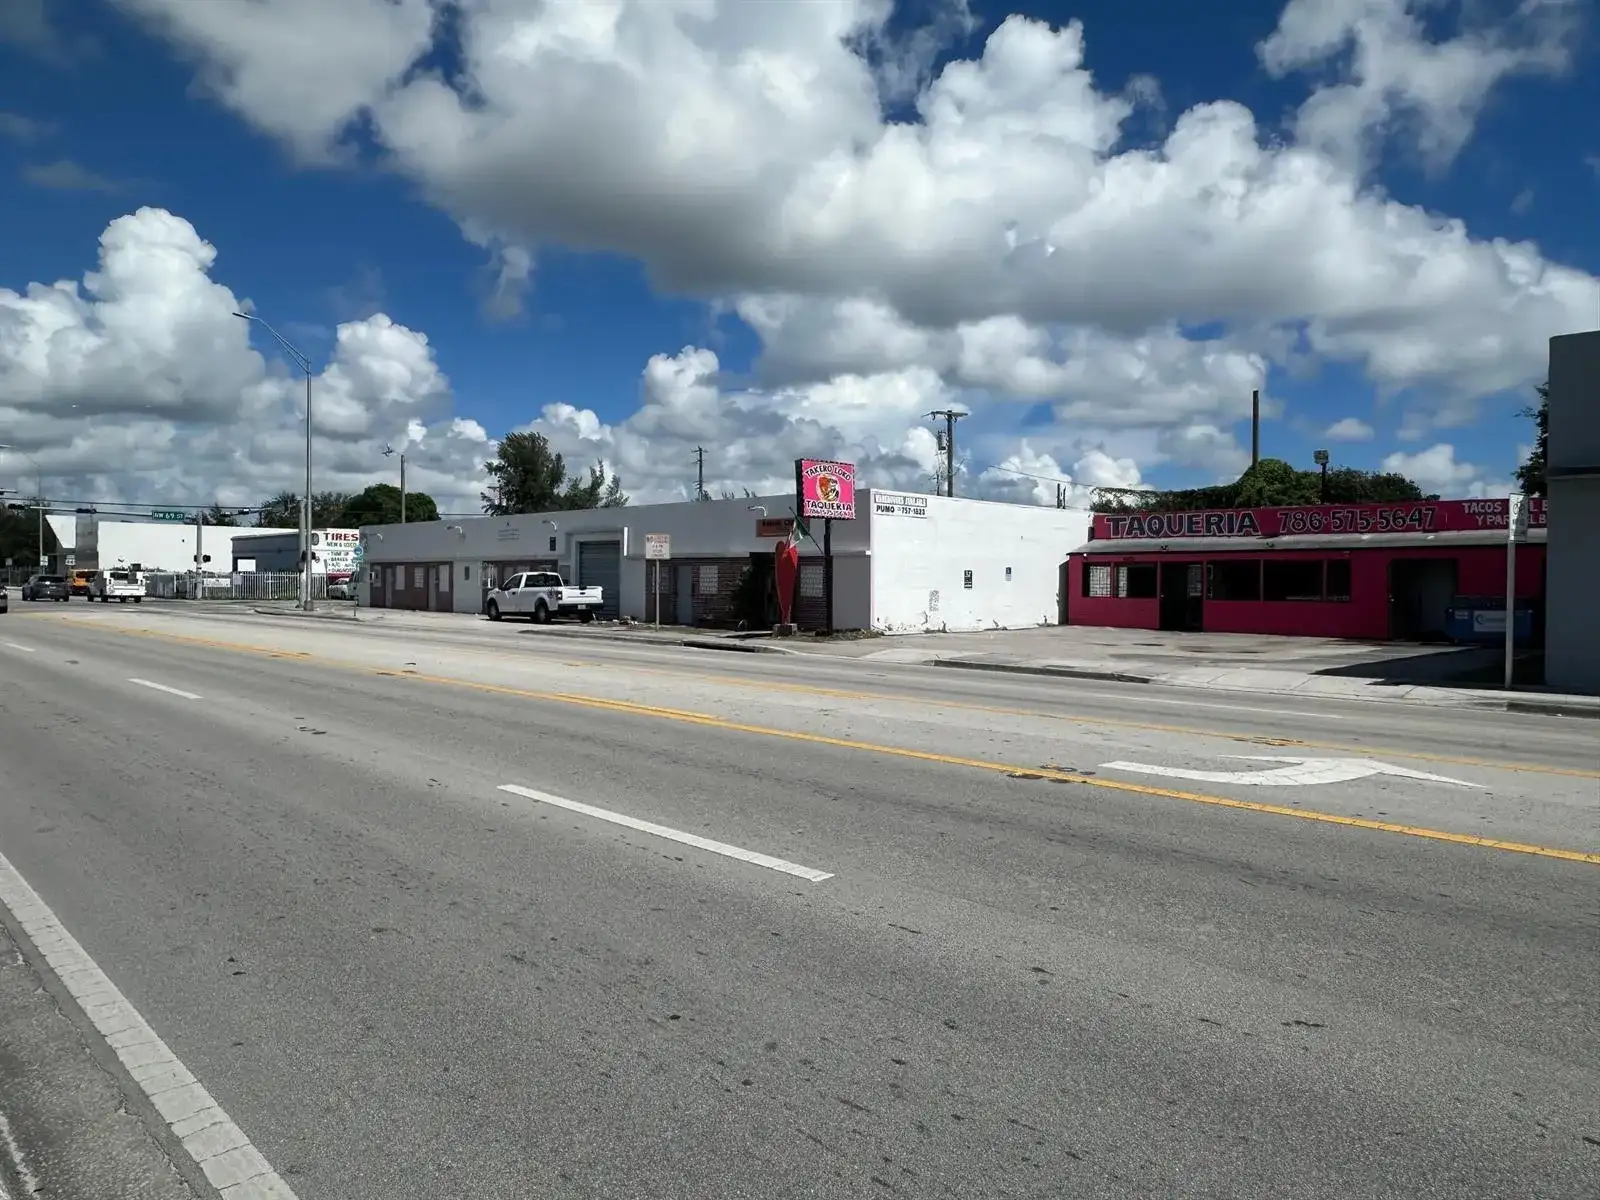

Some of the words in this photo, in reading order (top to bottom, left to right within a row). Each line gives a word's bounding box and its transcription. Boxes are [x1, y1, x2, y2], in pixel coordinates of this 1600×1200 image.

[805, 465, 833, 477] TAKERO
[834, 466, 851, 480] LOKO
[806, 500, 852, 511] TAQUERIA
[1462, 502, 1502, 514] TACOS
[1105, 511, 1262, 538] TAQUERIA
[1475, 515, 1484, 526] Y
[323, 532, 359, 541] TIRES
